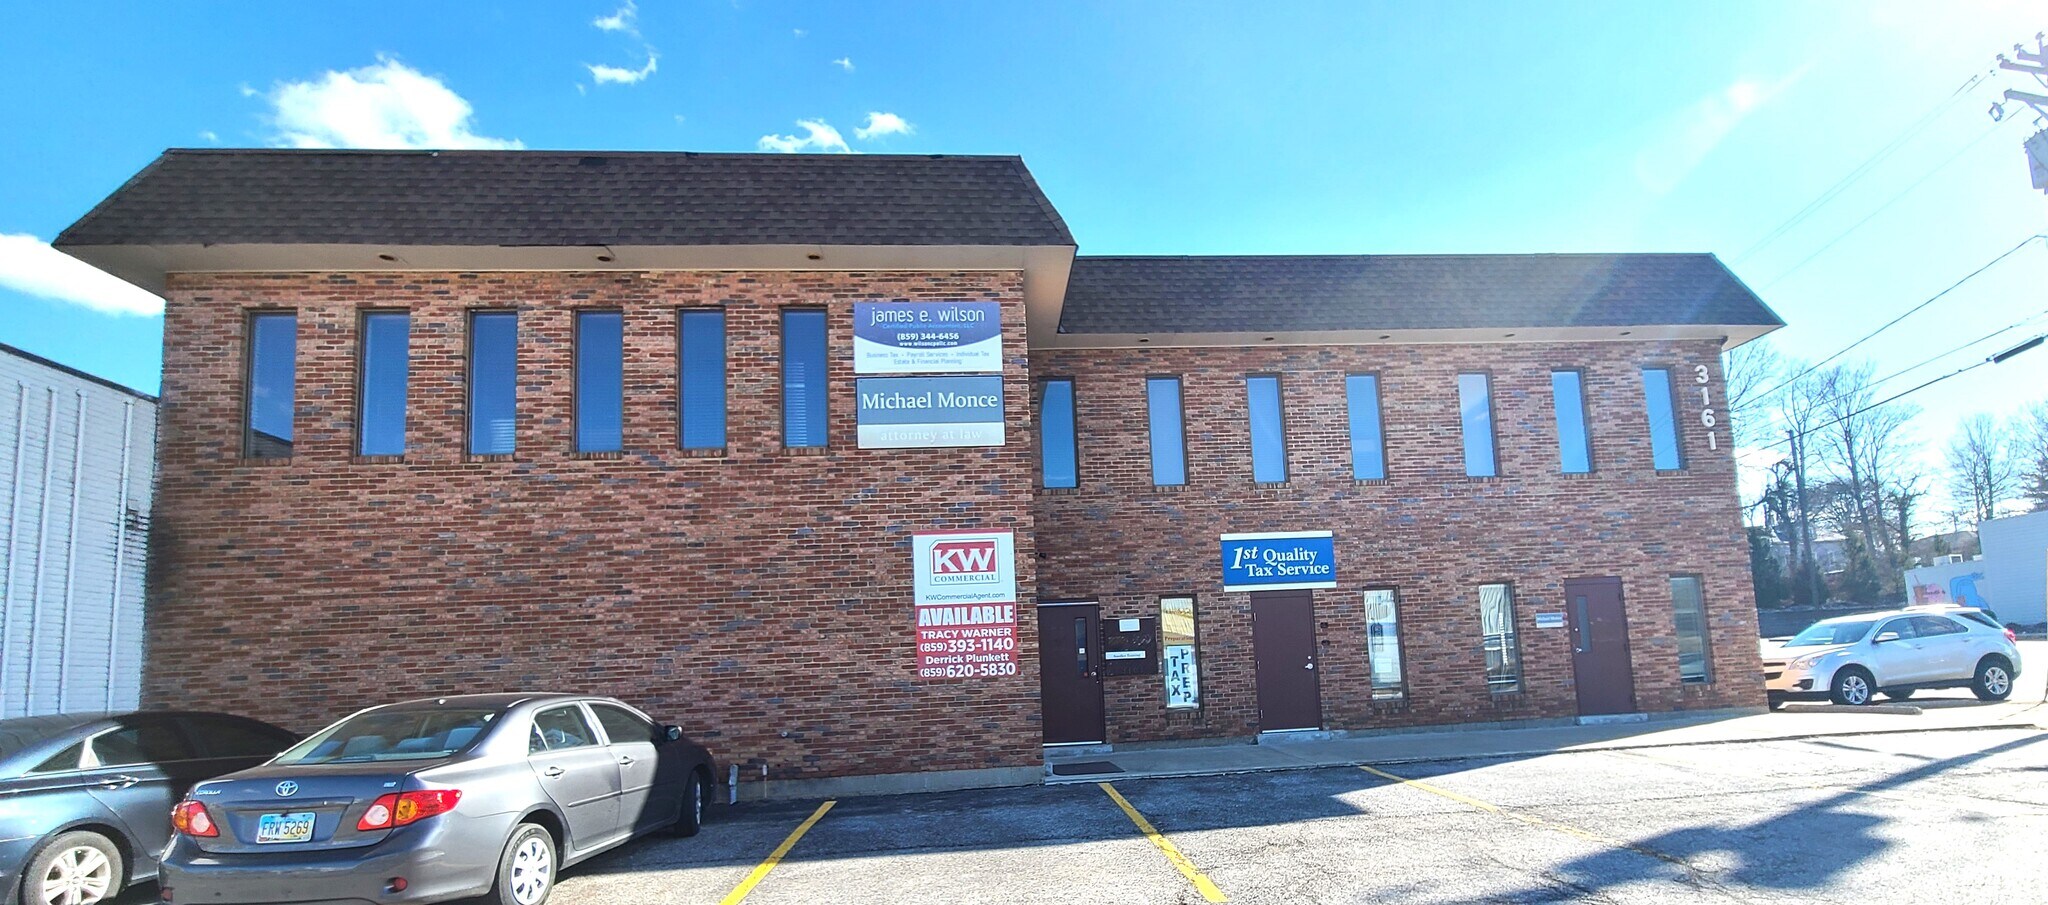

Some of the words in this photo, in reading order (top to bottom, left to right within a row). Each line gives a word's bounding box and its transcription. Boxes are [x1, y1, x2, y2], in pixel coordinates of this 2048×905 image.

[870, 306, 914, 327] james
[919, 310, 932, 322] e.
[937, 306, 985, 322] wilson
[896, 332, 919, 341] (859)
[920, 332, 960, 340] 344-6456
[862, 391, 932, 410] Michael
[937, 391, 998, 409] Monce
[1694, 364, 1717, 450] 3161
[880, 430, 938, 443] attorney
[942, 430, 954, 440] at
[959, 429, 983, 440] law
[933, 547, 995, 573] KW
[1230, 546, 1259, 569] 1st
[1263, 547, 1317, 567] Quality
[1245, 563, 1273, 577] Tax
[1277, 562, 1330, 576] Service
[934, 574, 997, 583] COMMERCIAL
[925, 592, 1006, 601] KWCommercialAgent.com
[918, 605, 1014, 627] AVAILABLE
[921, 629, 959, 640] TRACY
[962, 628, 1012, 638] WARNER
[920, 642, 947, 653] (859)
[948, 637, 1014, 653] 393-1140
[925, 654, 964, 665] Derrick
[966, 653, 1010, 663] Plunkett
[920, 667, 946, 677] (859)
[946, 662, 1016, 678] 620-5830
[1170, 655, 1181, 696] TAX
[1180, 648, 1192, 702] PREP
[283, 820, 310, 836] 5269
